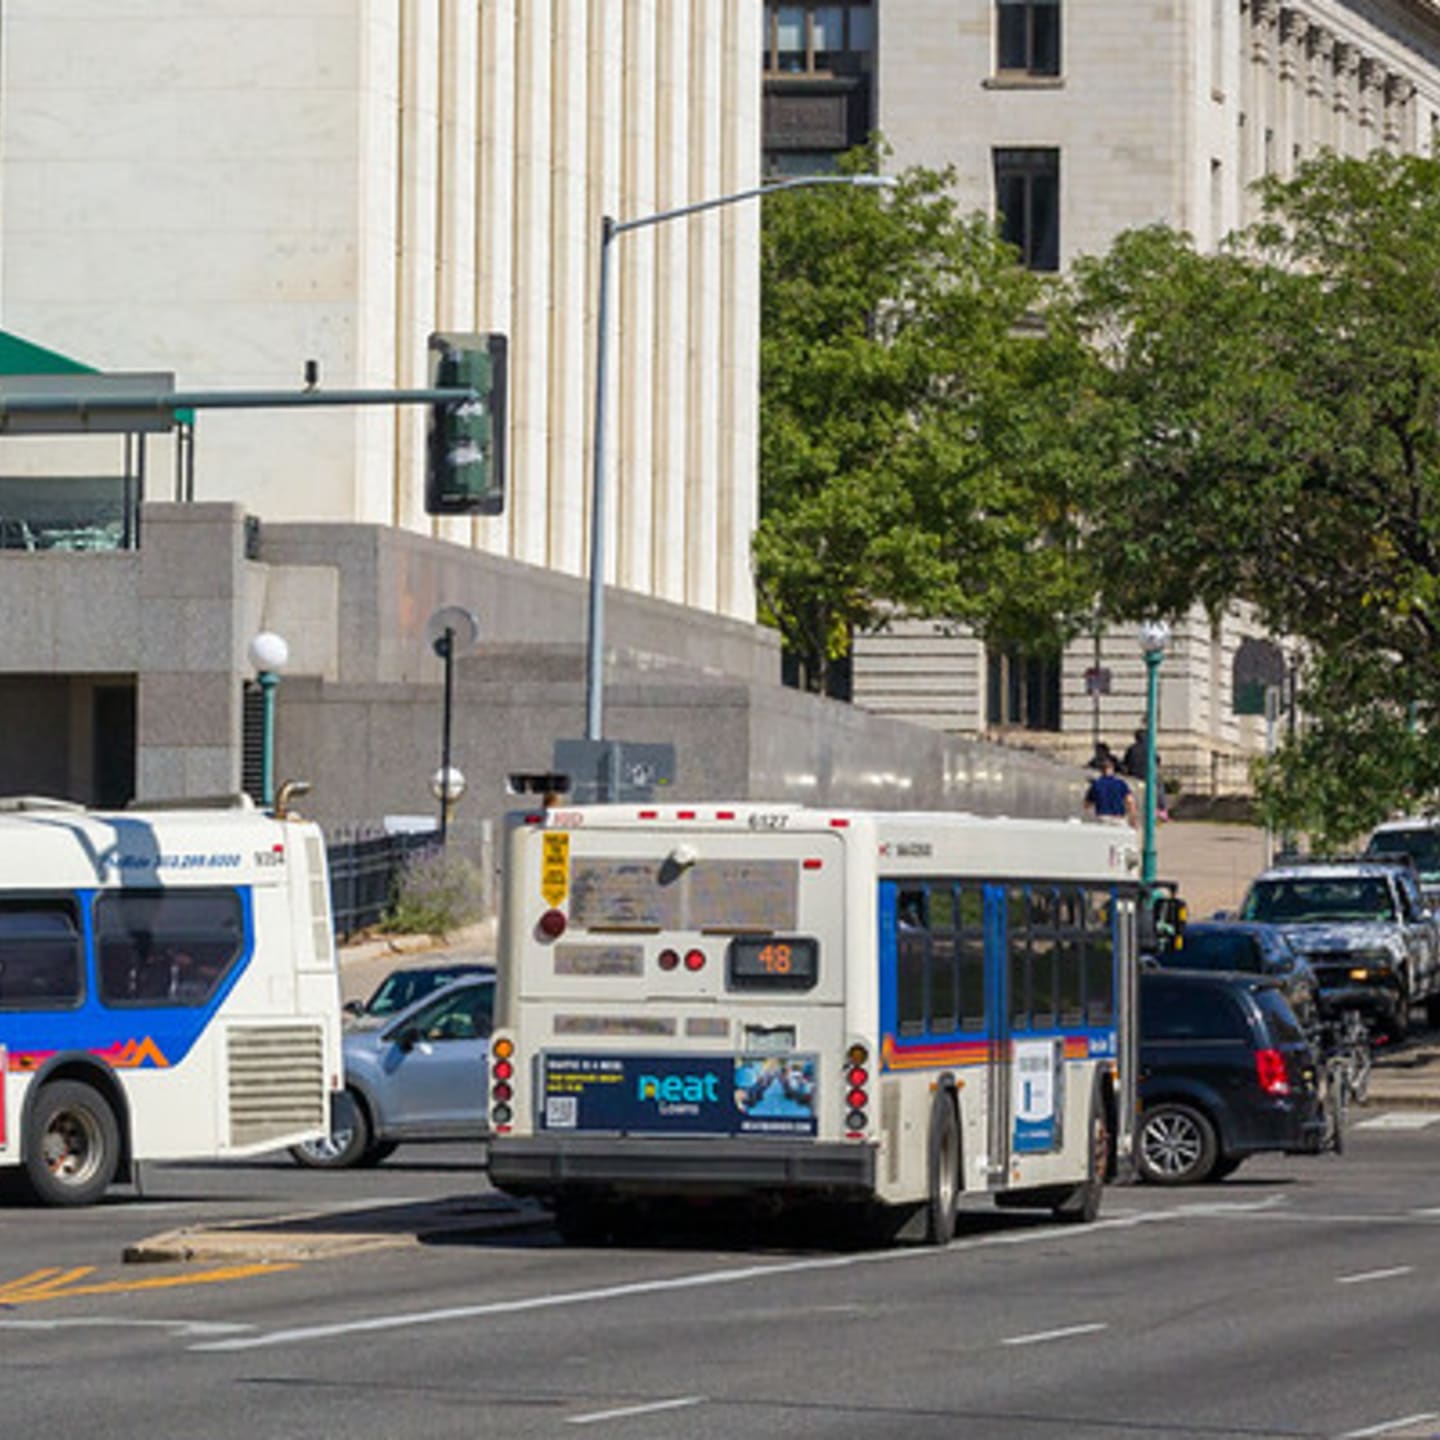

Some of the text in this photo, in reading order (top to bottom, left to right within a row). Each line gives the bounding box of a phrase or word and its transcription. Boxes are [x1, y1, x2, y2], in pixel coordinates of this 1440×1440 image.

[758, 944, 791, 974] 48
[638, 1072, 719, 1102] neat
[659, 1101, 700, 1116] Loans
